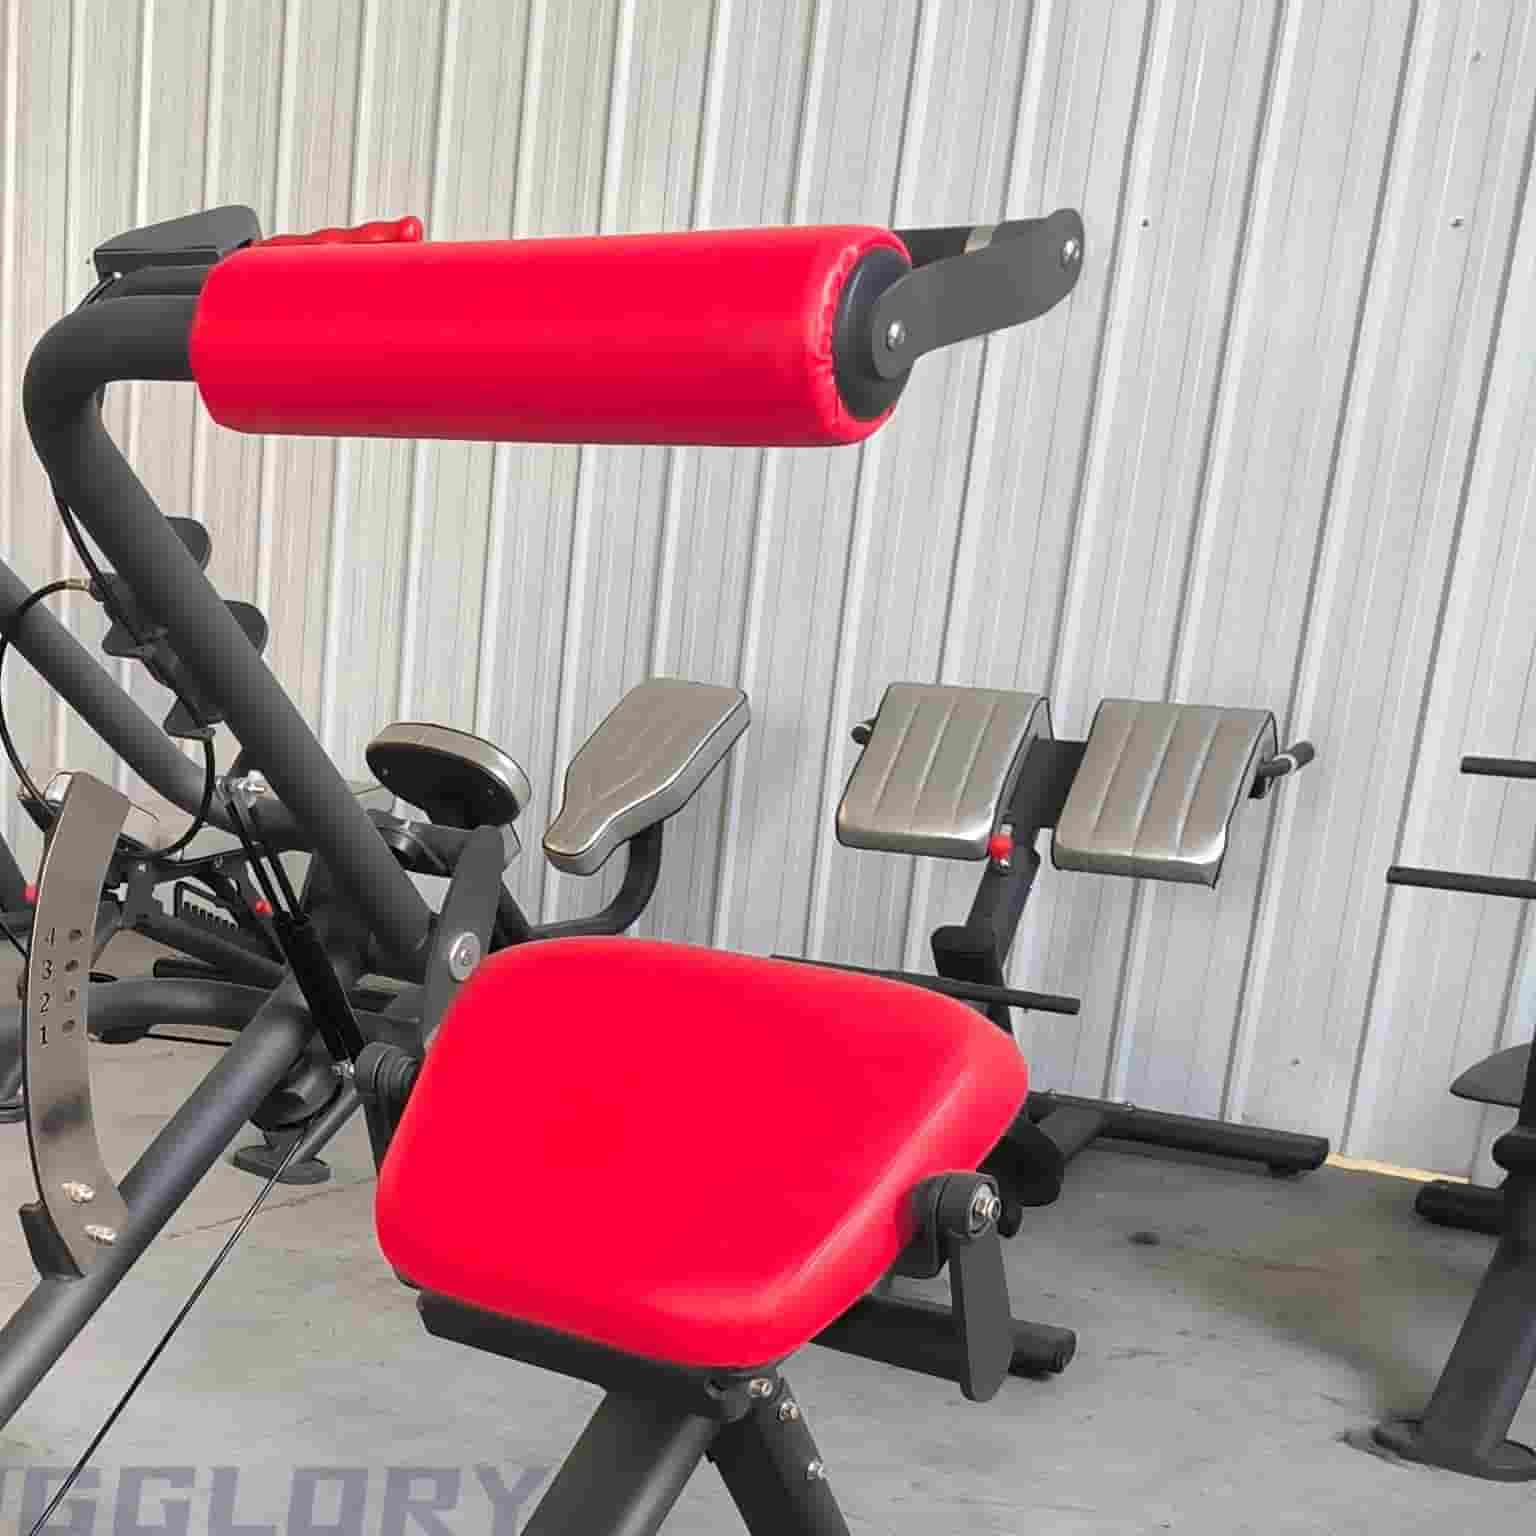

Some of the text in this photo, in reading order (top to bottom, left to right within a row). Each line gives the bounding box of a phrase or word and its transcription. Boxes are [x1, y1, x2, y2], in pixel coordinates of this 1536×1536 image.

[41, 958, 53, 981] 3
[39, 991, 51, 1015] 2
[39, 1023, 49, 1046] 1
